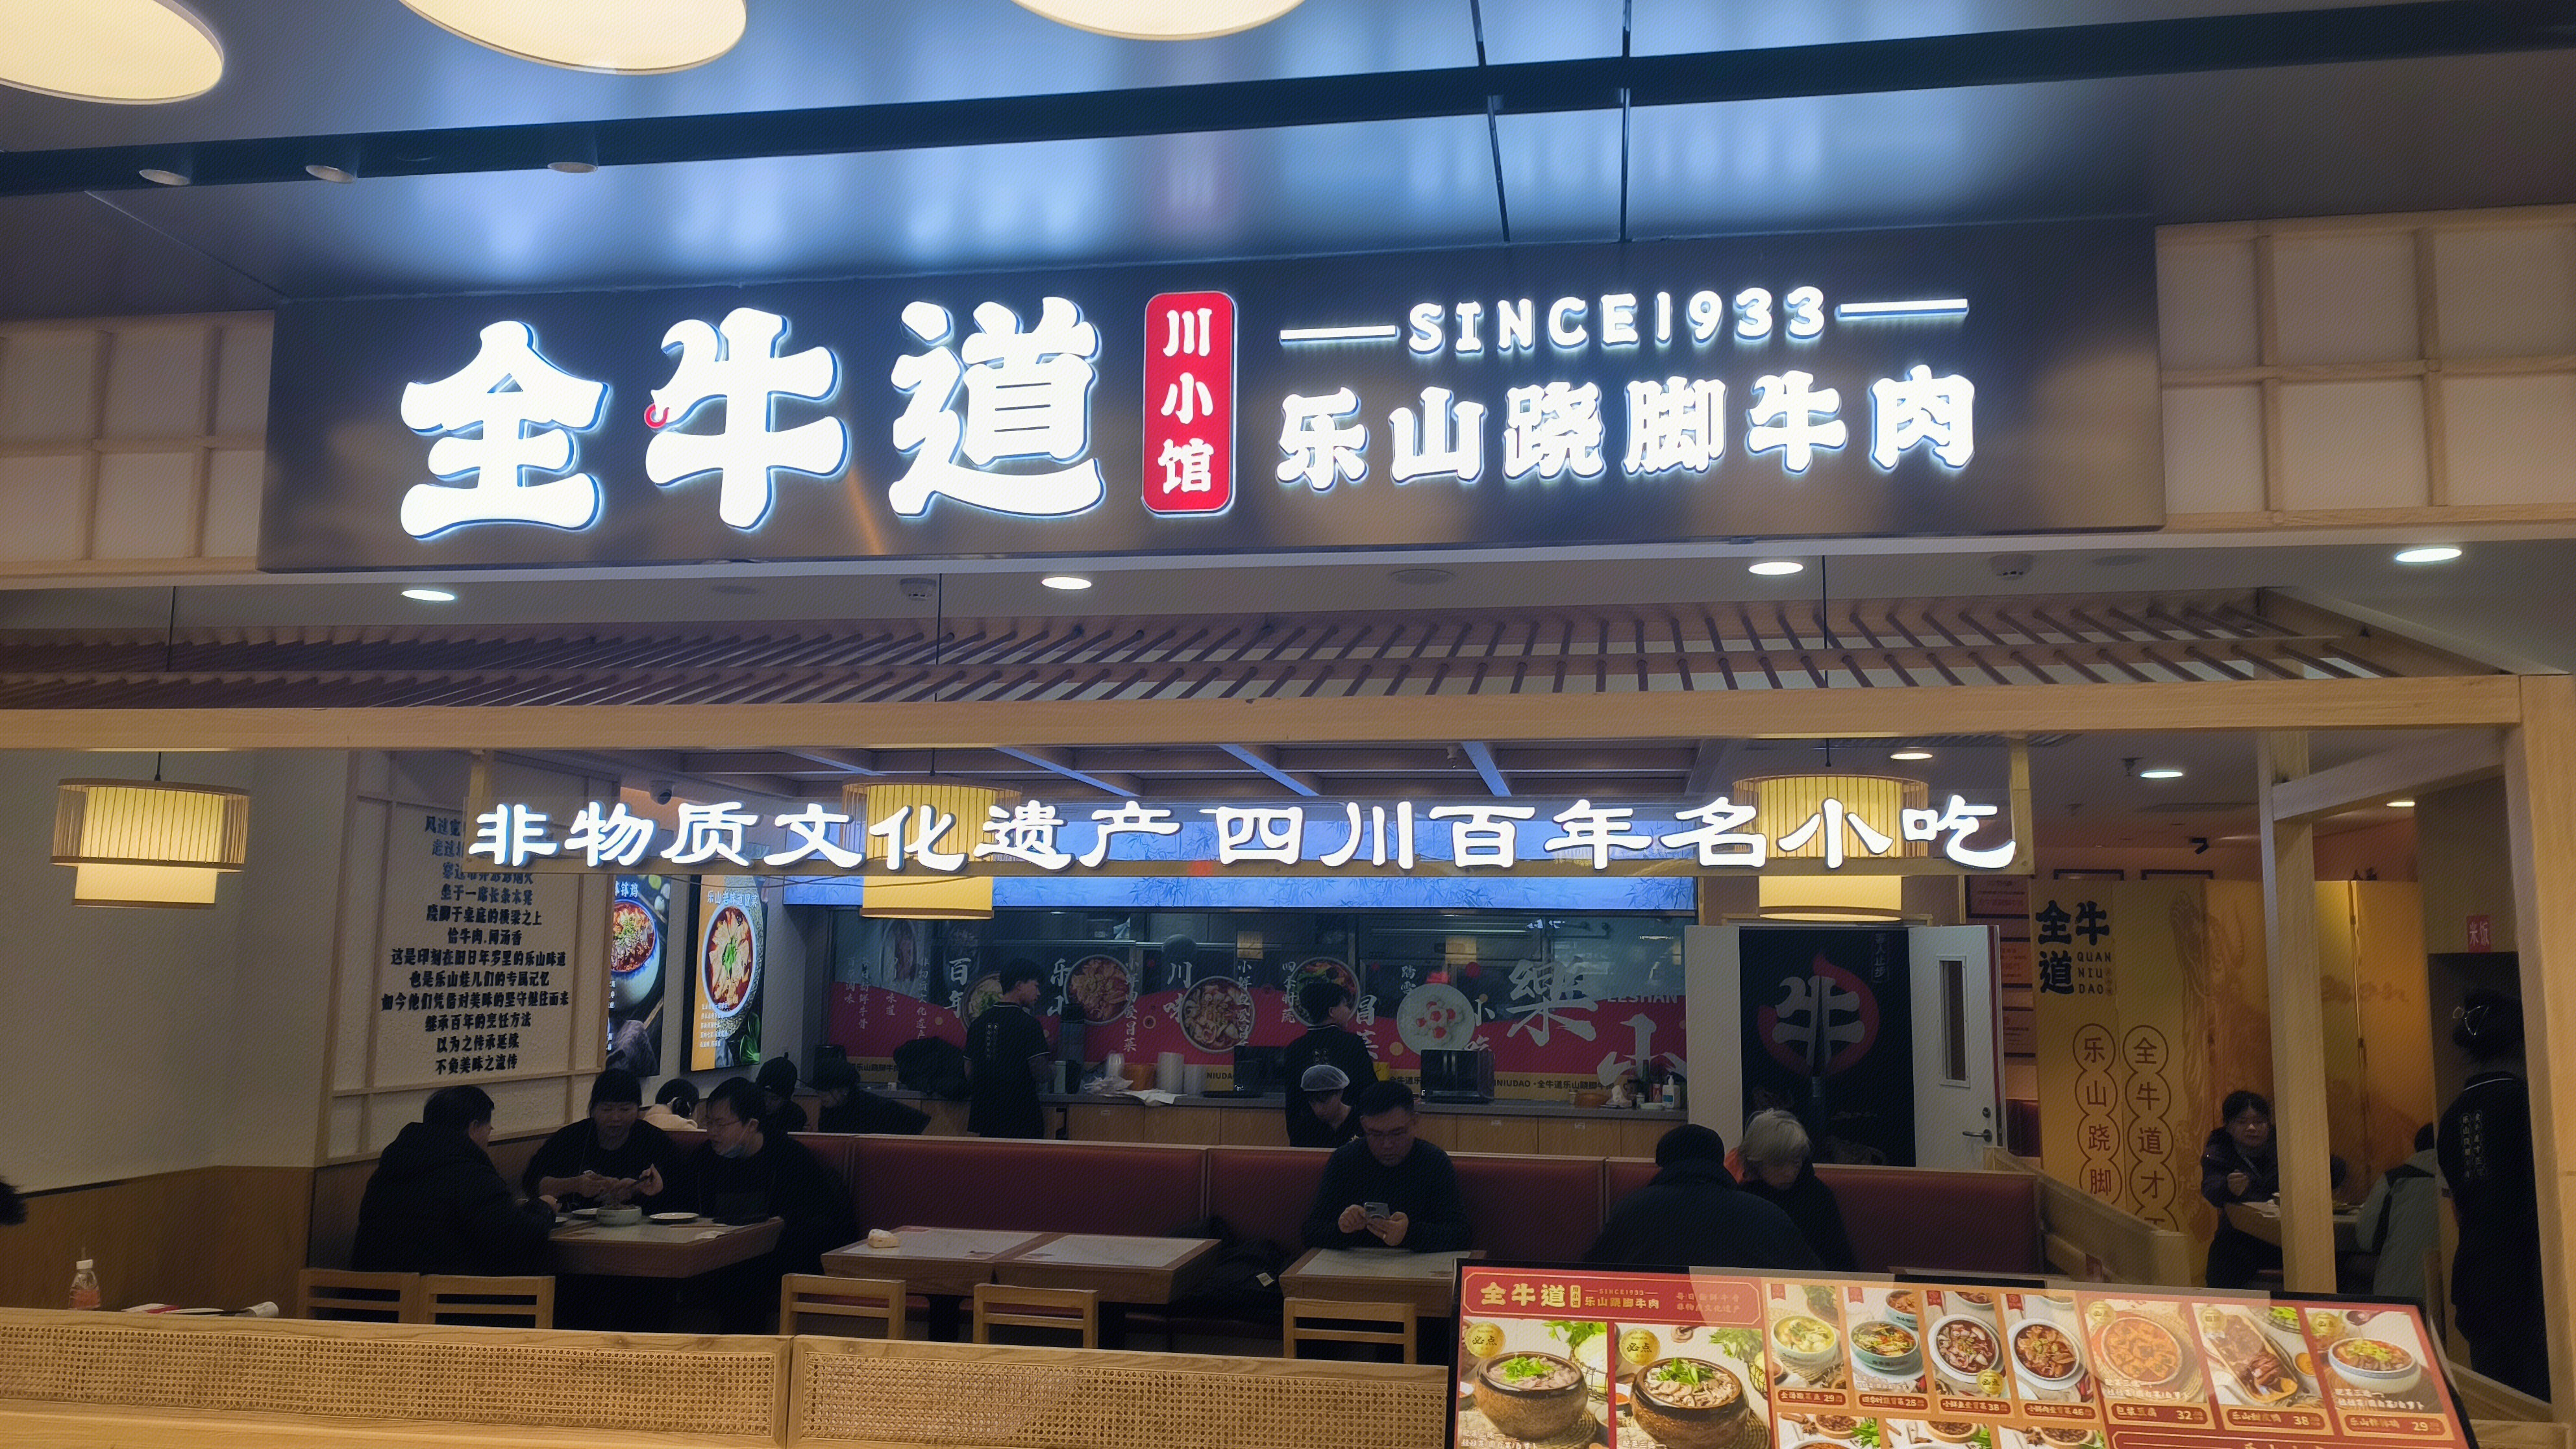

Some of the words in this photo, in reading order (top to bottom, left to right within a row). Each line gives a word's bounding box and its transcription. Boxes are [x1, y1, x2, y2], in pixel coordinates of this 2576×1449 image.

[1408, 287, 1826, 354] SINCE1933
[1157, 307, 1215, 495] 川小馆
[400, 296, 1106, 539] 全牛道
[1276, 365, 1976, 491] 乐山跷脚牛肉
[2077, 951, 2112, 963] QUAN
[2077, 967, 2103, 978] NIU
[944, 958, 971, 1019] 百年
[2078, 983, 2104, 995] DAO
[2083, 1036, 2112, 1196] 乐山跷脚
[1480, 1282, 1567, 1308] 全牛道
[1585, 1296, 1660, 1310] 乐山跷脚牛肉
[1626, 1342, 1653, 1353] 必点
[2175, 1409, 2194, 1421] 32
[2292, 1415, 2310, 1426] 38
[2411, 1420, 2429, 1432] 29
